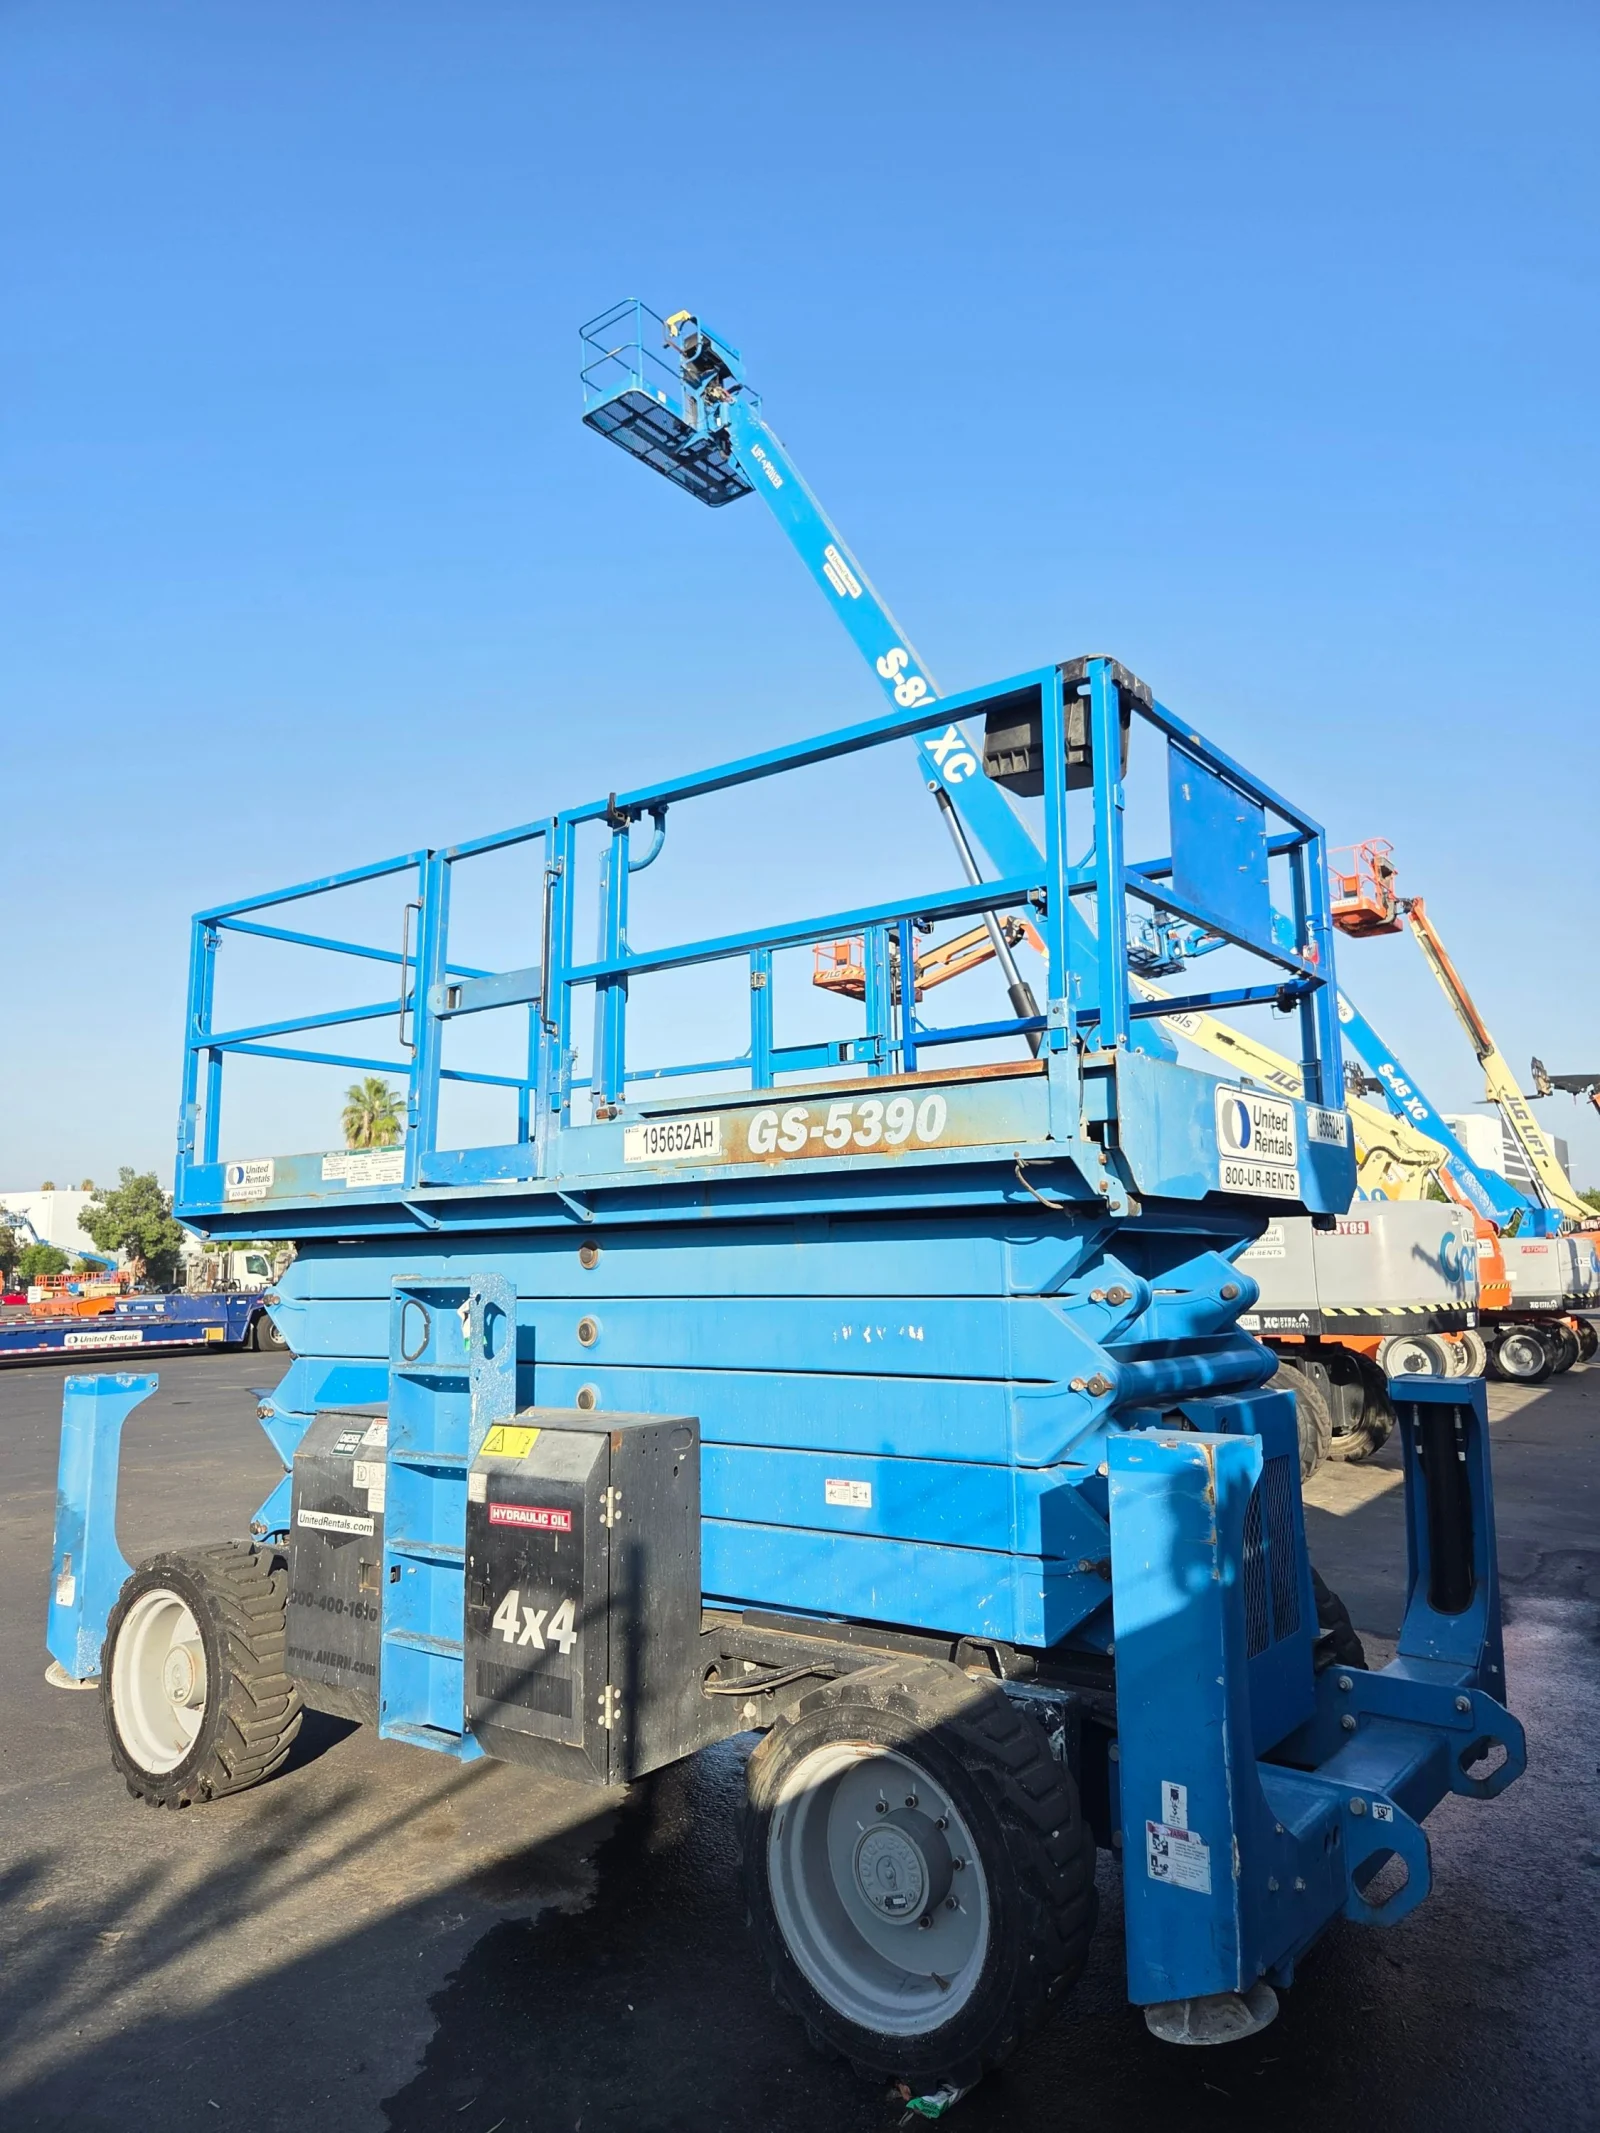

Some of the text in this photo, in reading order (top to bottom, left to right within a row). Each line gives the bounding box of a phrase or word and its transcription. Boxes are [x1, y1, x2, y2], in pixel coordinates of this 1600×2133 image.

[924, 725, 977, 784] XC
[1264, 1071, 1302, 1092] JLG
[1378, 1063, 1429, 1121] S-45 XC
[747, 1094, 947, 1154] GS-5390
[1253, 1105, 1288, 1132] United
[1504, 1094, 1549, 1157] JLG LIFT
[643, 1120, 713, 1154] 195652AH
[1254, 1130, 1292, 1156] Rentals
[245, 1164, 269, 1174] United
[245, 1174, 271, 1184] Rentals
[1225, 1166, 1295, 1191] 800-UR-RENTS
[1263, 1316, 1279, 1329] XC
[80, 1333, 138, 1343] United Rentals
[299, 1513, 373, 1533] UnitedRentals.com
[493, 1508, 568, 1527] HYDRAULIC OIL
[492, 1589, 578, 1654] 4x4
[287, 1646, 376, 1677] www.AHERN.com
